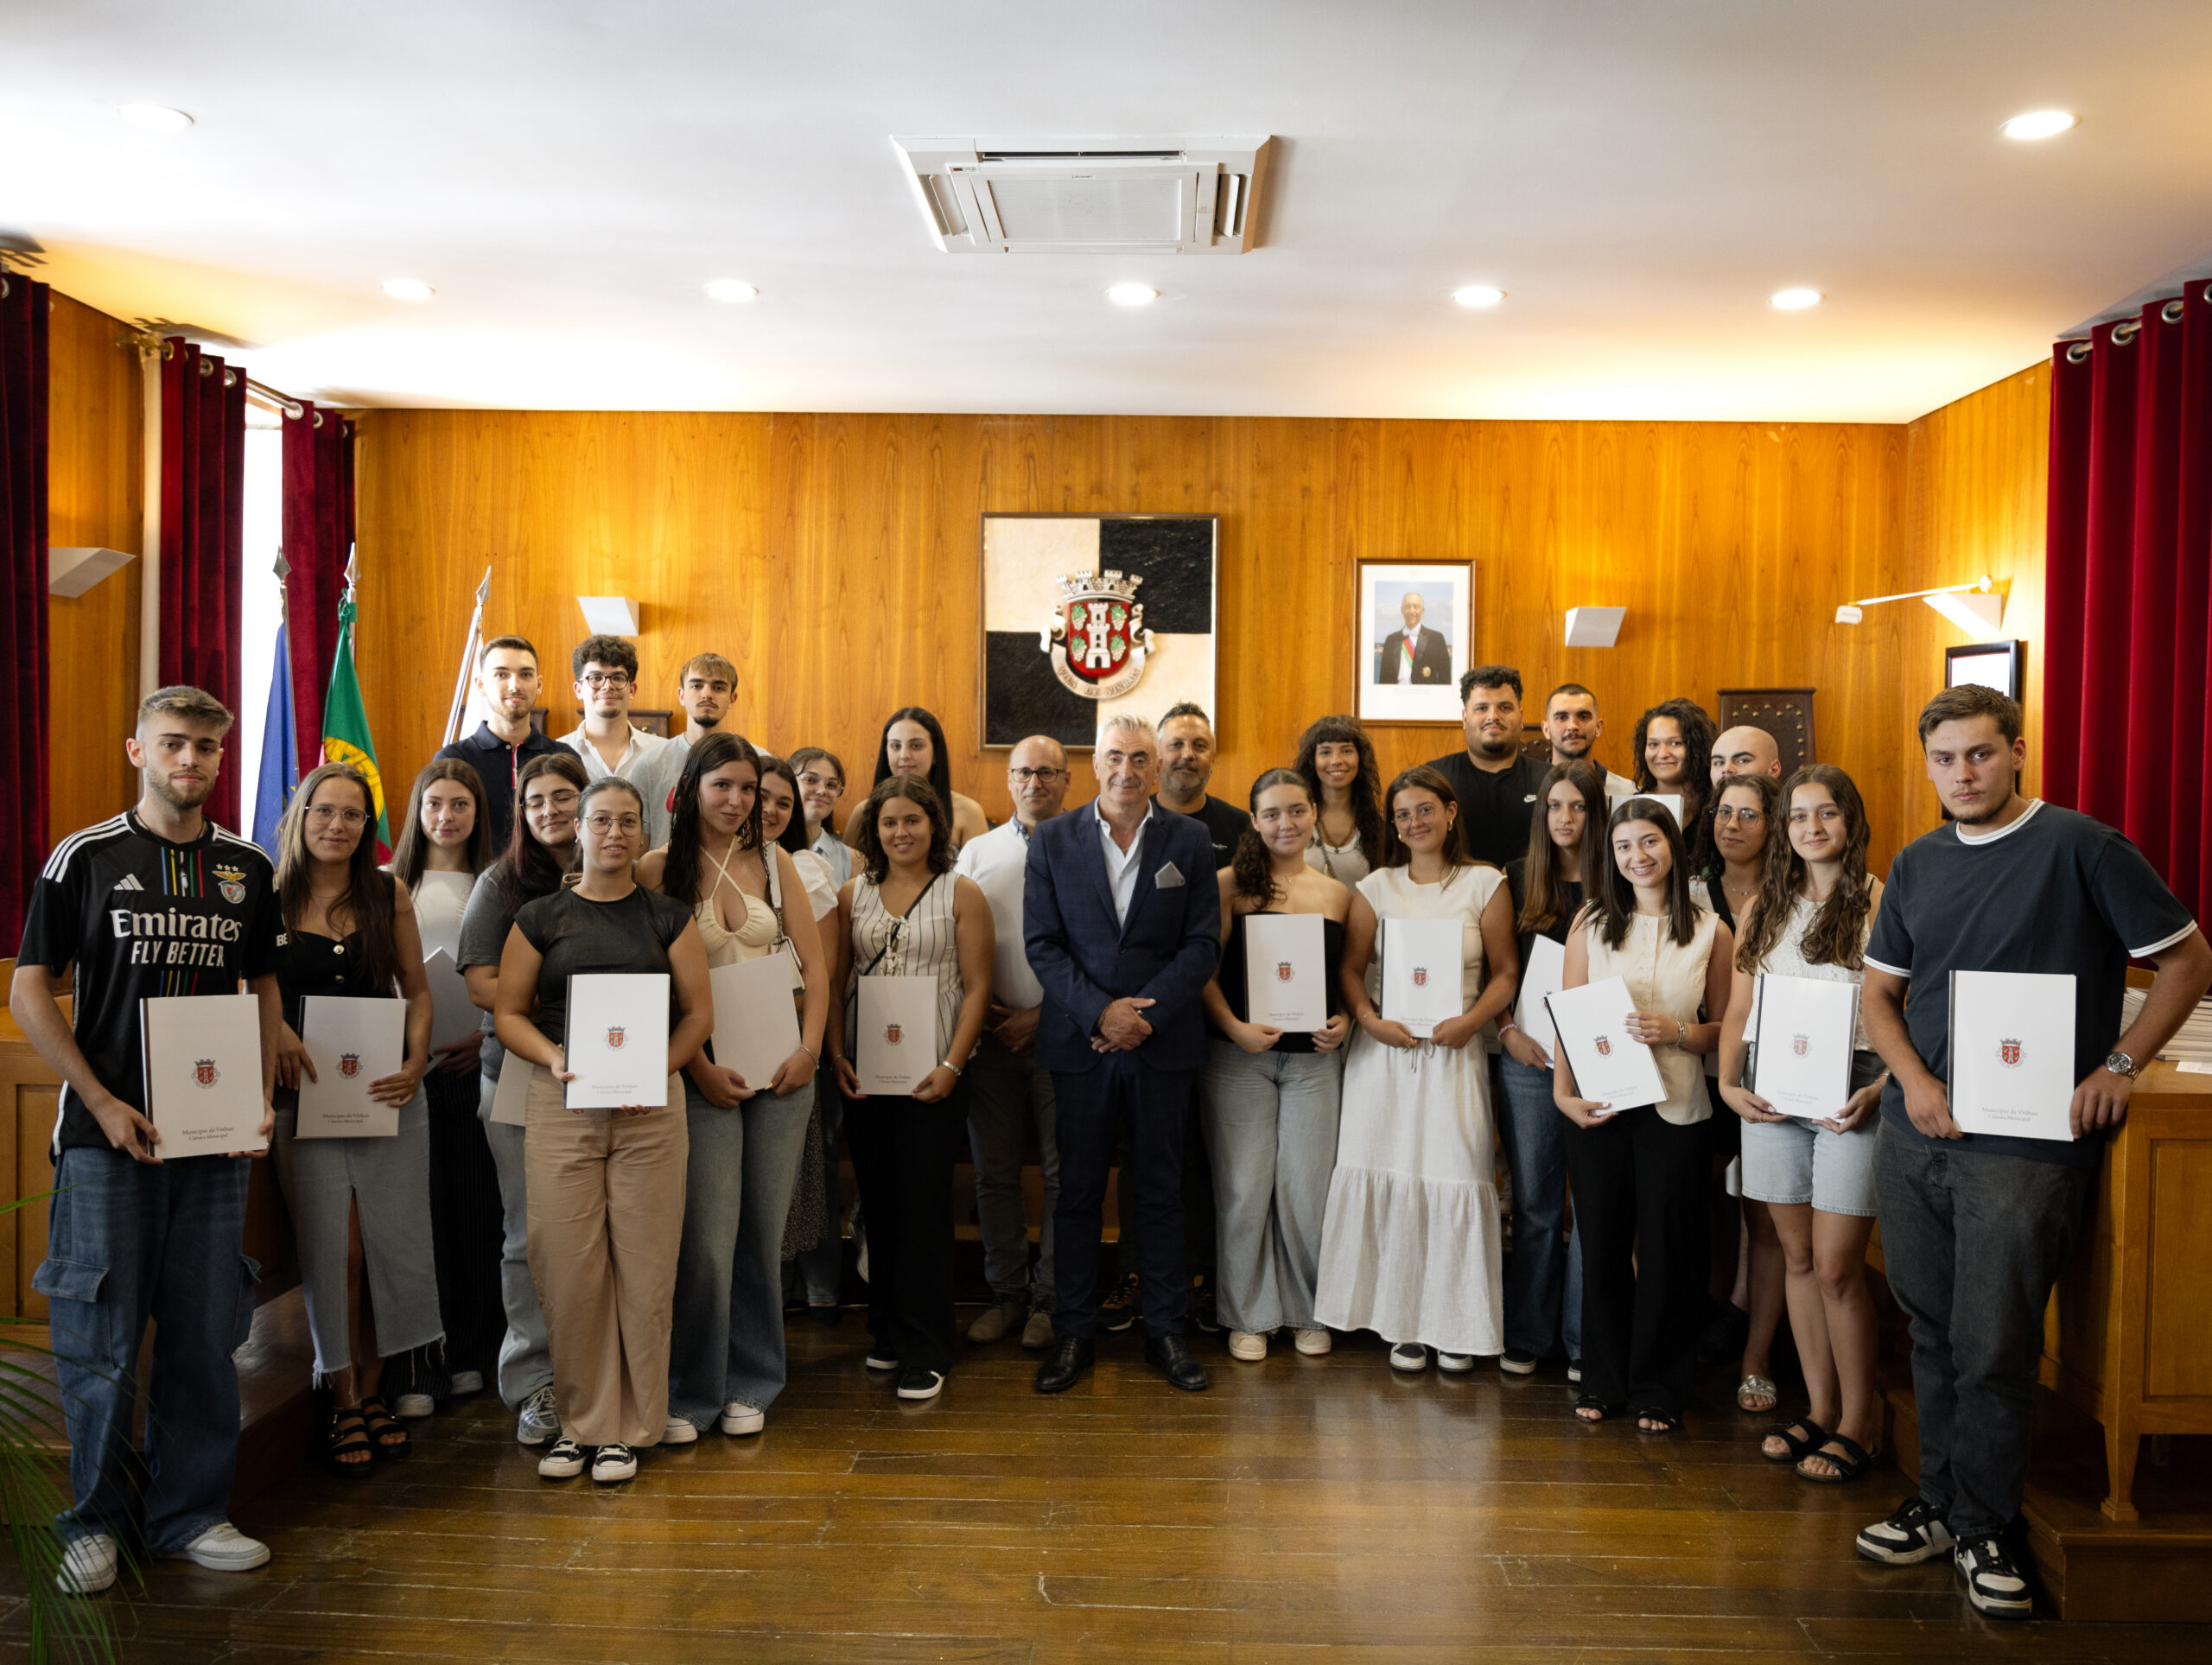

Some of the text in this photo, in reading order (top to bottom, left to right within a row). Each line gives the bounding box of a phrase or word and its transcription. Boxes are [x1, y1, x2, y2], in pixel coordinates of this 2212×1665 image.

[110, 907, 243, 943] Emirates
[130, 940, 225, 968] FLY BETTER
